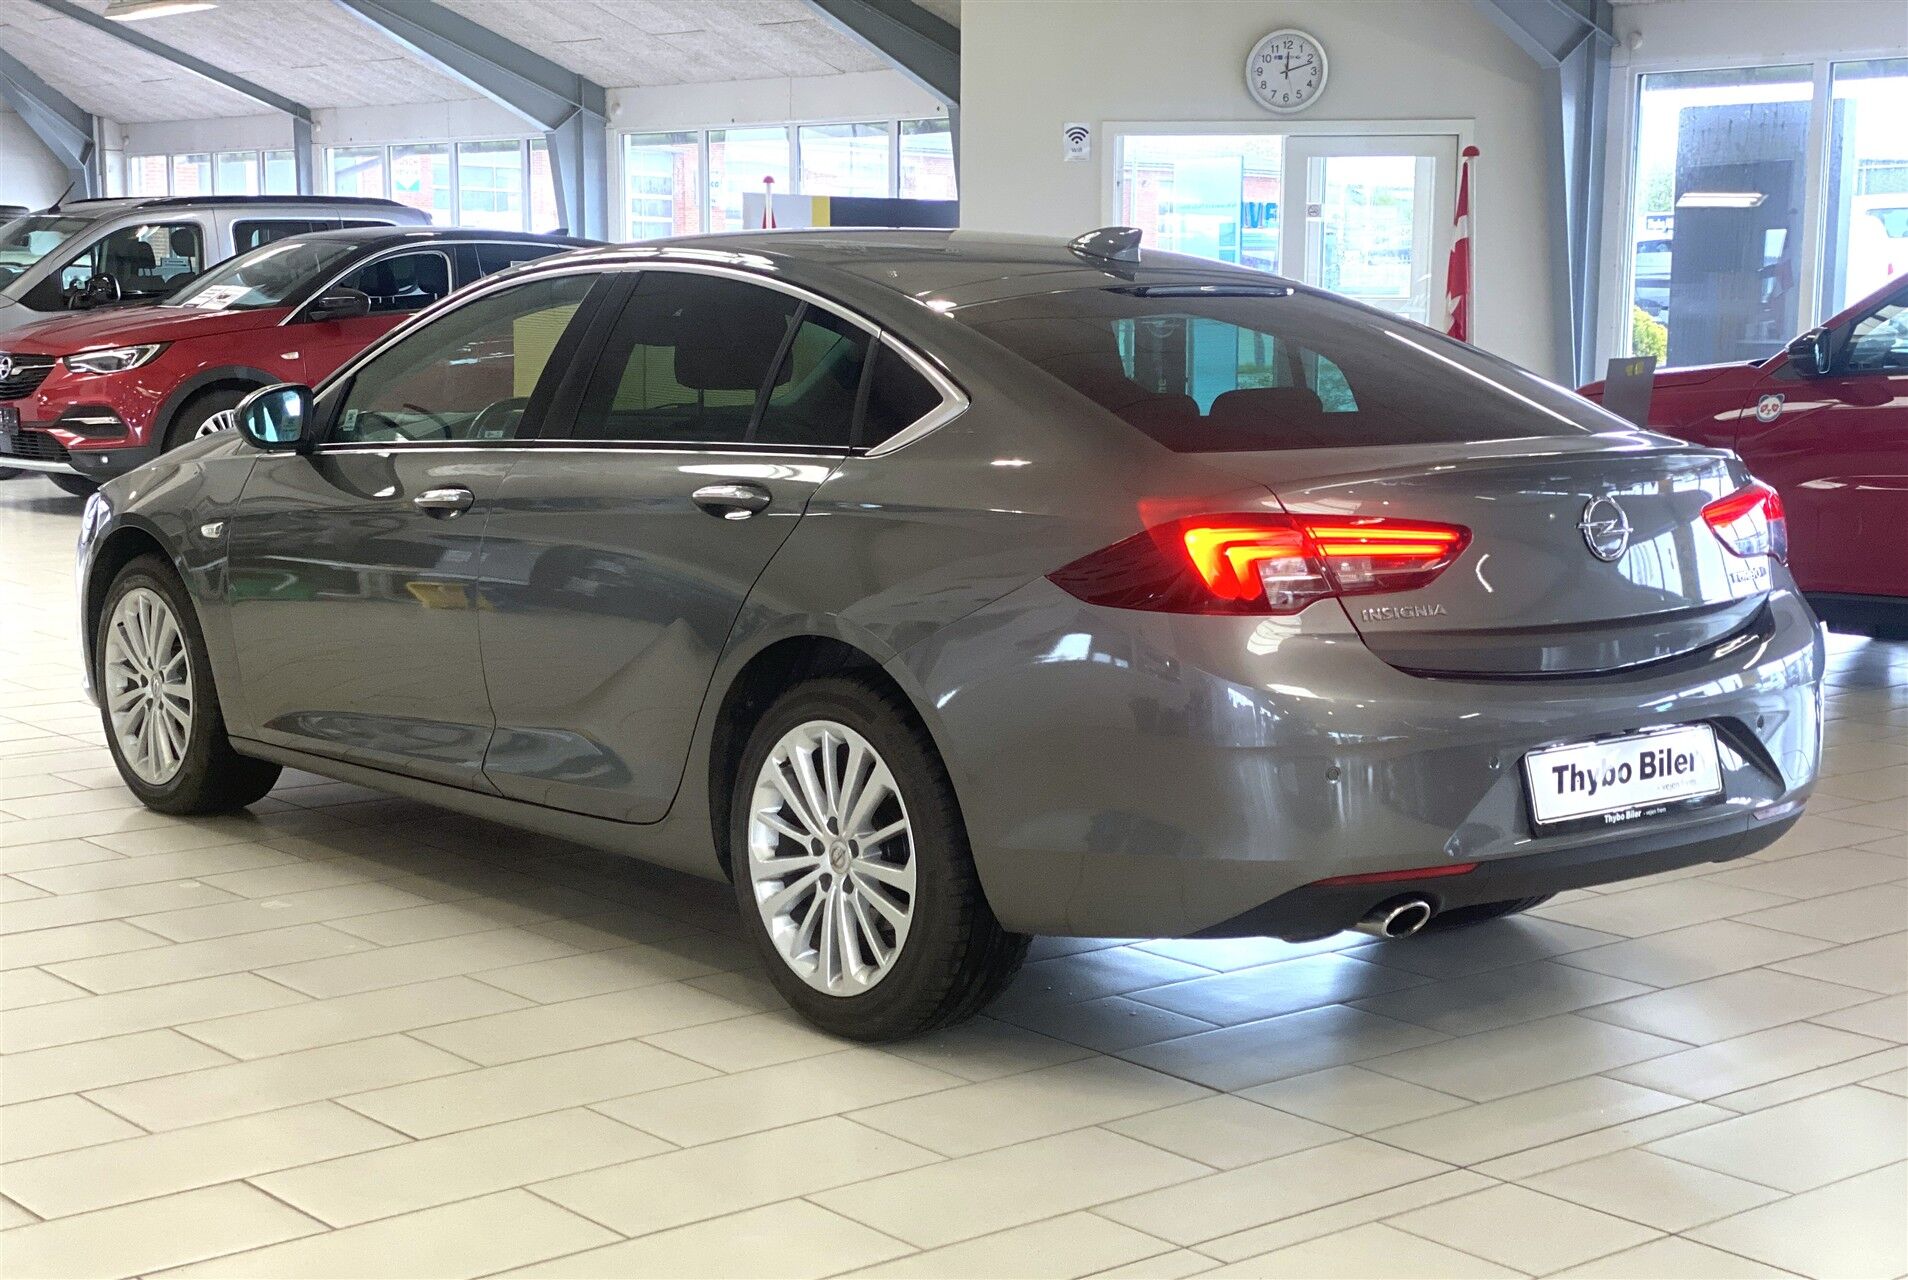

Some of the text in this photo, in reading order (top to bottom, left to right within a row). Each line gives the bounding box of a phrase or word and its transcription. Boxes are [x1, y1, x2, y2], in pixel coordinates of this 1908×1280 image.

[1271, 45, 1279, 53] 11
[1283, 40, 1294, 50] 12
[1261, 54, 1272, 63] 10
[1307, 53, 1314, 63] 2
[1256, 67, 1263, 76] 9
[1311, 66, 1317, 76] 3
[1260, 80, 1267, 90] 8
[1306, 79, 1312, 88] 4
[1271, 89, 1277, 99] 7
[1282, 93, 1289, 102] 6
[1296, 89, 1302, 99] 5
[1362, 604, 1447, 622] INSIGNIA
[1552, 748, 1696, 796] Thybo Biler
[1604, 812, 1625, 824] Thybo
[1625, 809, 1642, 820] Biler
